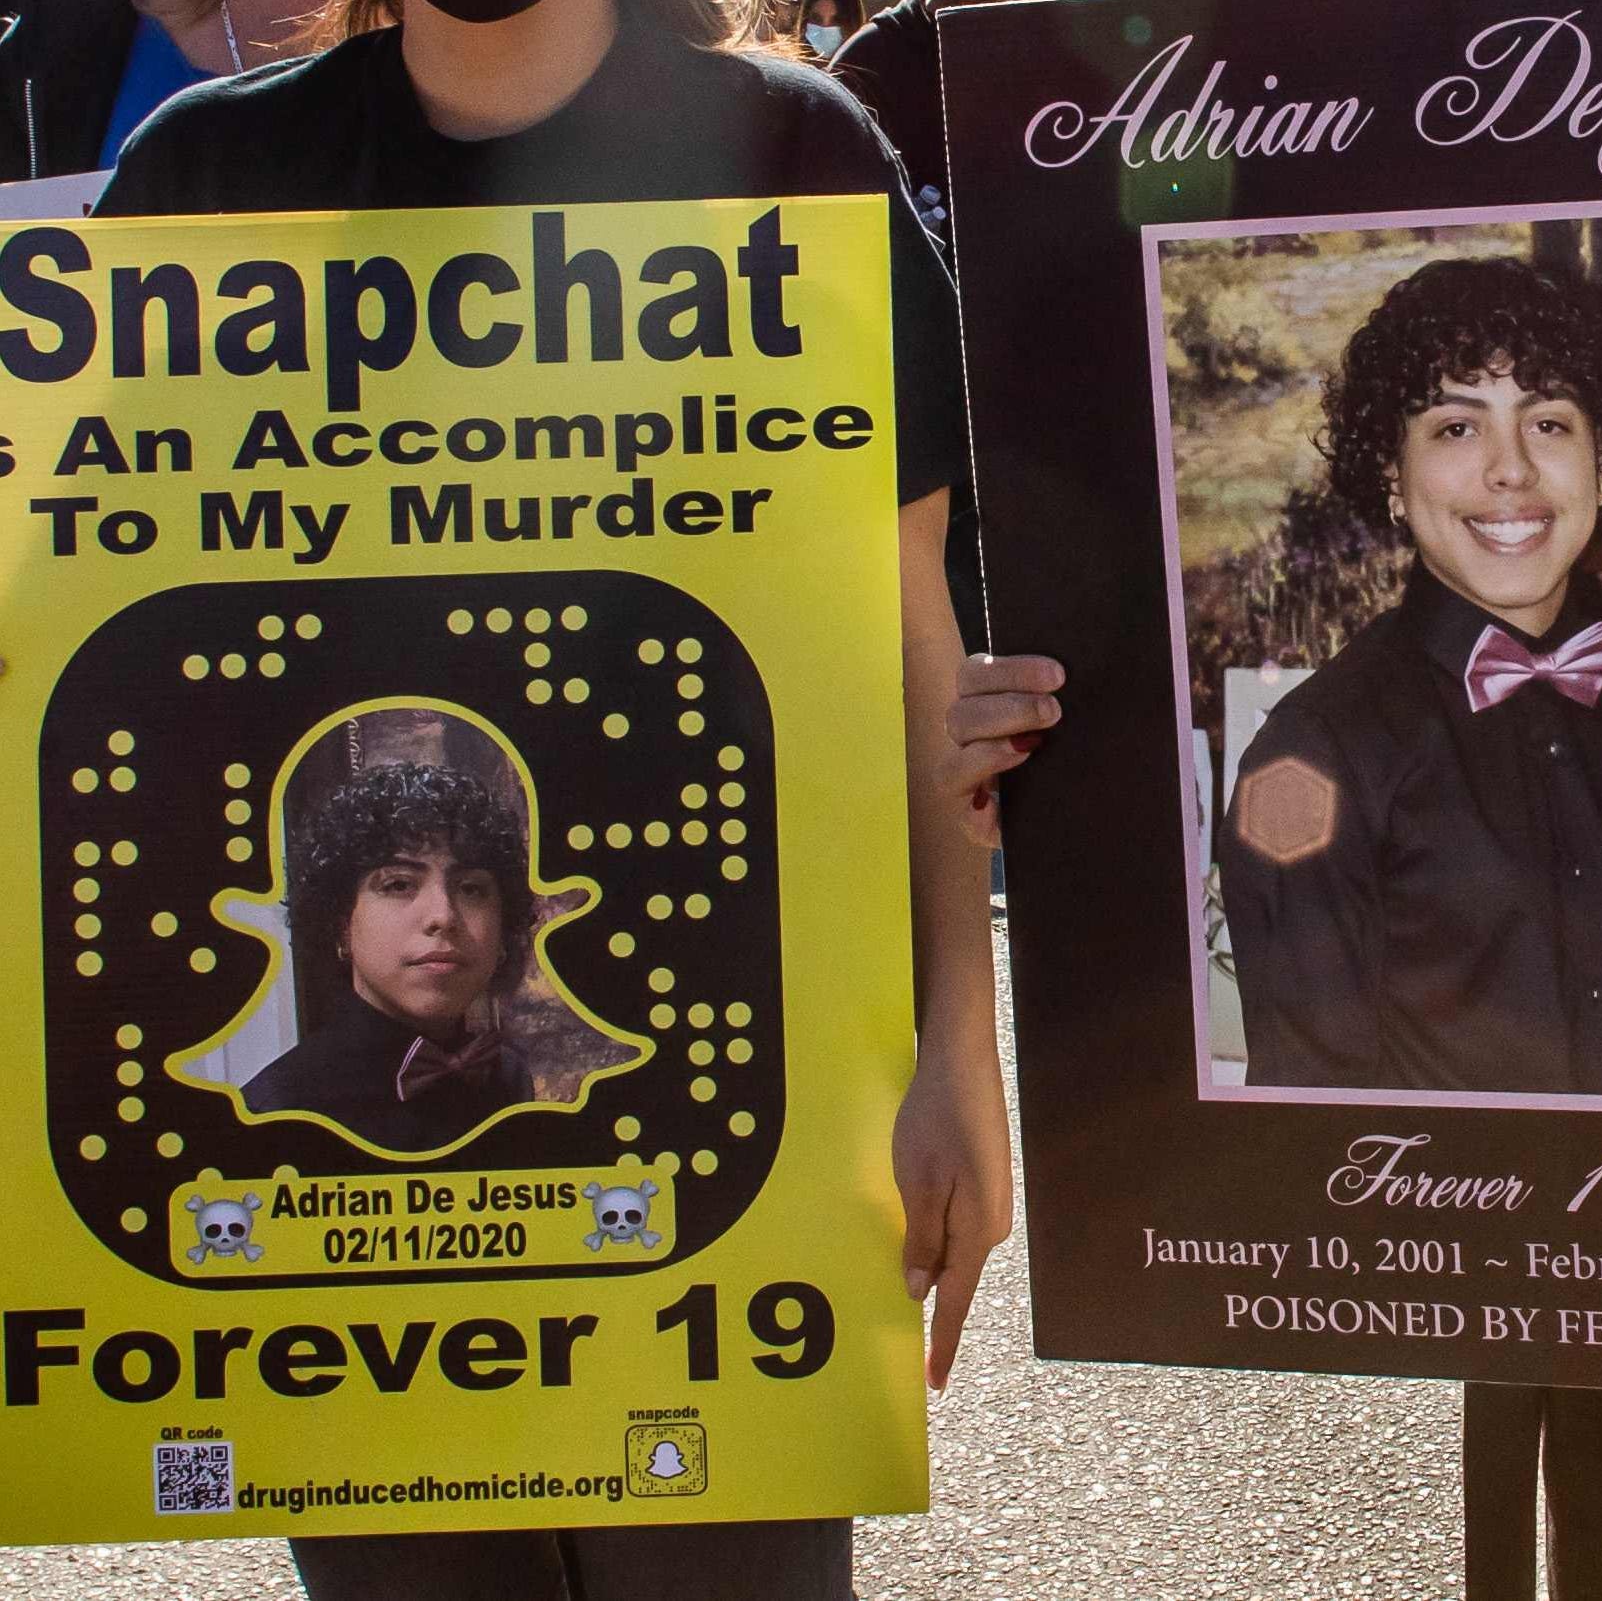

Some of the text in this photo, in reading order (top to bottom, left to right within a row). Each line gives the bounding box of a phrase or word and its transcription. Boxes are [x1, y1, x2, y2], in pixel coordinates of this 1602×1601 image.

[1024, 35, 1374, 169] Adrian
[0, 204, 804, 412] Snapchat
[53, 414, 192, 476] An
[232, 394, 874, 473] Accomplice
[30, 476, 773, 565] To My Murder
[1326, 1134, 1534, 1211] Forever
[271, 1177, 578, 1220] Adrian De Jesus
[323, 1222, 527, 1265] 02/11/2020
[1142, 1228, 1291, 1279] January
[1306, 1236, 1361, 1276] 10,
[1375, 1239, 1466, 1275] 2001
[1224, 1294, 1466, 1337] POISONED
[1481, 1305, 1542, 1342] BY
[2, 1282, 836, 1407] Forever 19
[160, 1426, 224, 1440] QR code
[628, 1406, 700, 1422] snapcode
[238, 1475, 624, 1514] druginducedhomicide.org
